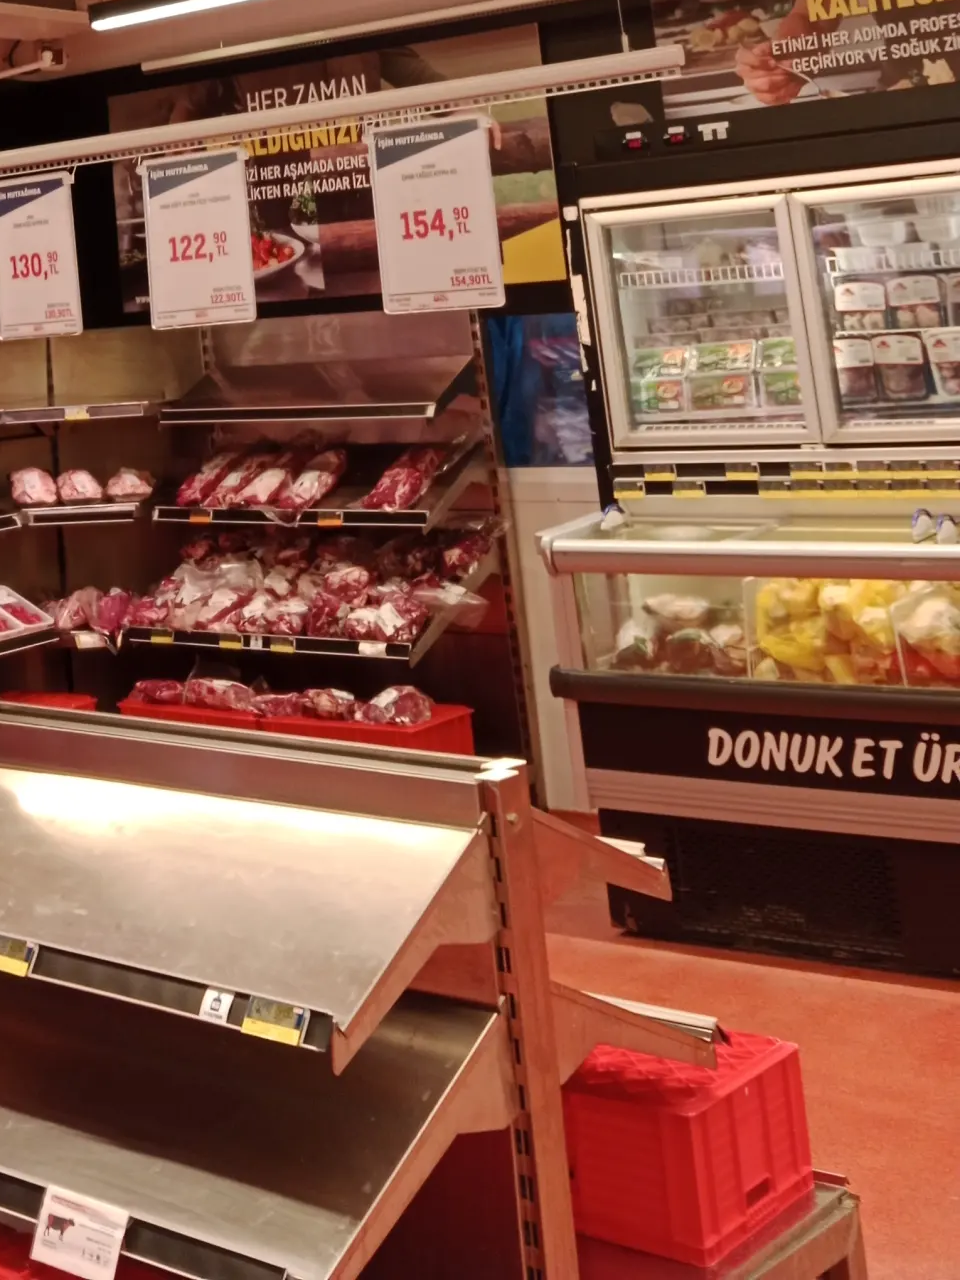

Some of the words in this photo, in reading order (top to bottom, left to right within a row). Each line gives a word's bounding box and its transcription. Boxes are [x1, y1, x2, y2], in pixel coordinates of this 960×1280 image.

[772, 32, 818, 56] ETİNİZİ
[821, 30, 850, 48] HER
[853, 21, 907, 44] ADIMDA
[792, 49, 865, 74] GEÇİRİYOR
[868, 45, 888, 62] VE
[890, 37, 941, 59] SOĞUK
[246, 87, 287, 112] HER
[293, 73, 367, 107] ZAMAN
[260, 164, 281, 180] HER
[284, 158, 335, 181] AŞAMADA
[283, 181, 311, 198] RAFA
[313, 177, 351, 194] KADAR
[456, 221, 471, 234] TL
[217, 245, 228, 256] TL
[49, 264, 59, 275] TL
[708, 727, 843, 778] DONUK
[852, 737, 904, 780] ET
